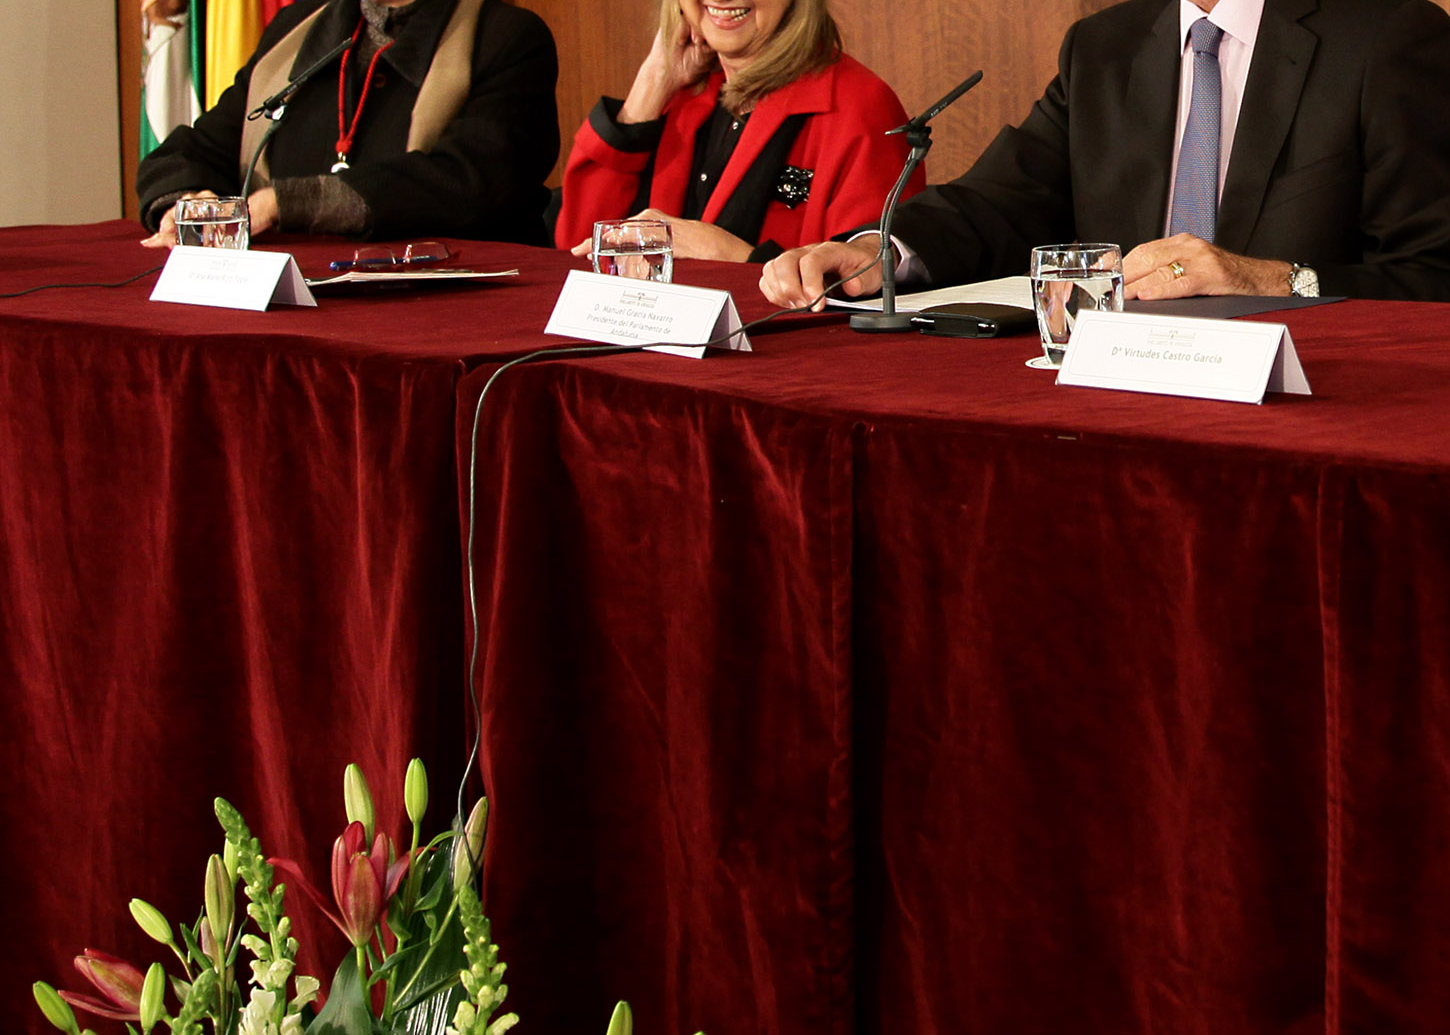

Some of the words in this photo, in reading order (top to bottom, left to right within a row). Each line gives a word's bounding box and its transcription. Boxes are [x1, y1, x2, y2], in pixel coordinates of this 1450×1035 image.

[586, 313, 617, 325] Presidente
[618, 319, 628, 327] del
[629, 320, 662, 333] Parlamento
[602, 305, 625, 315] Manuel
[648, 312, 674, 323] Navarro
[1124, 347, 1160, 359] Virtudes
[1162, 350, 1191, 361] Castro
